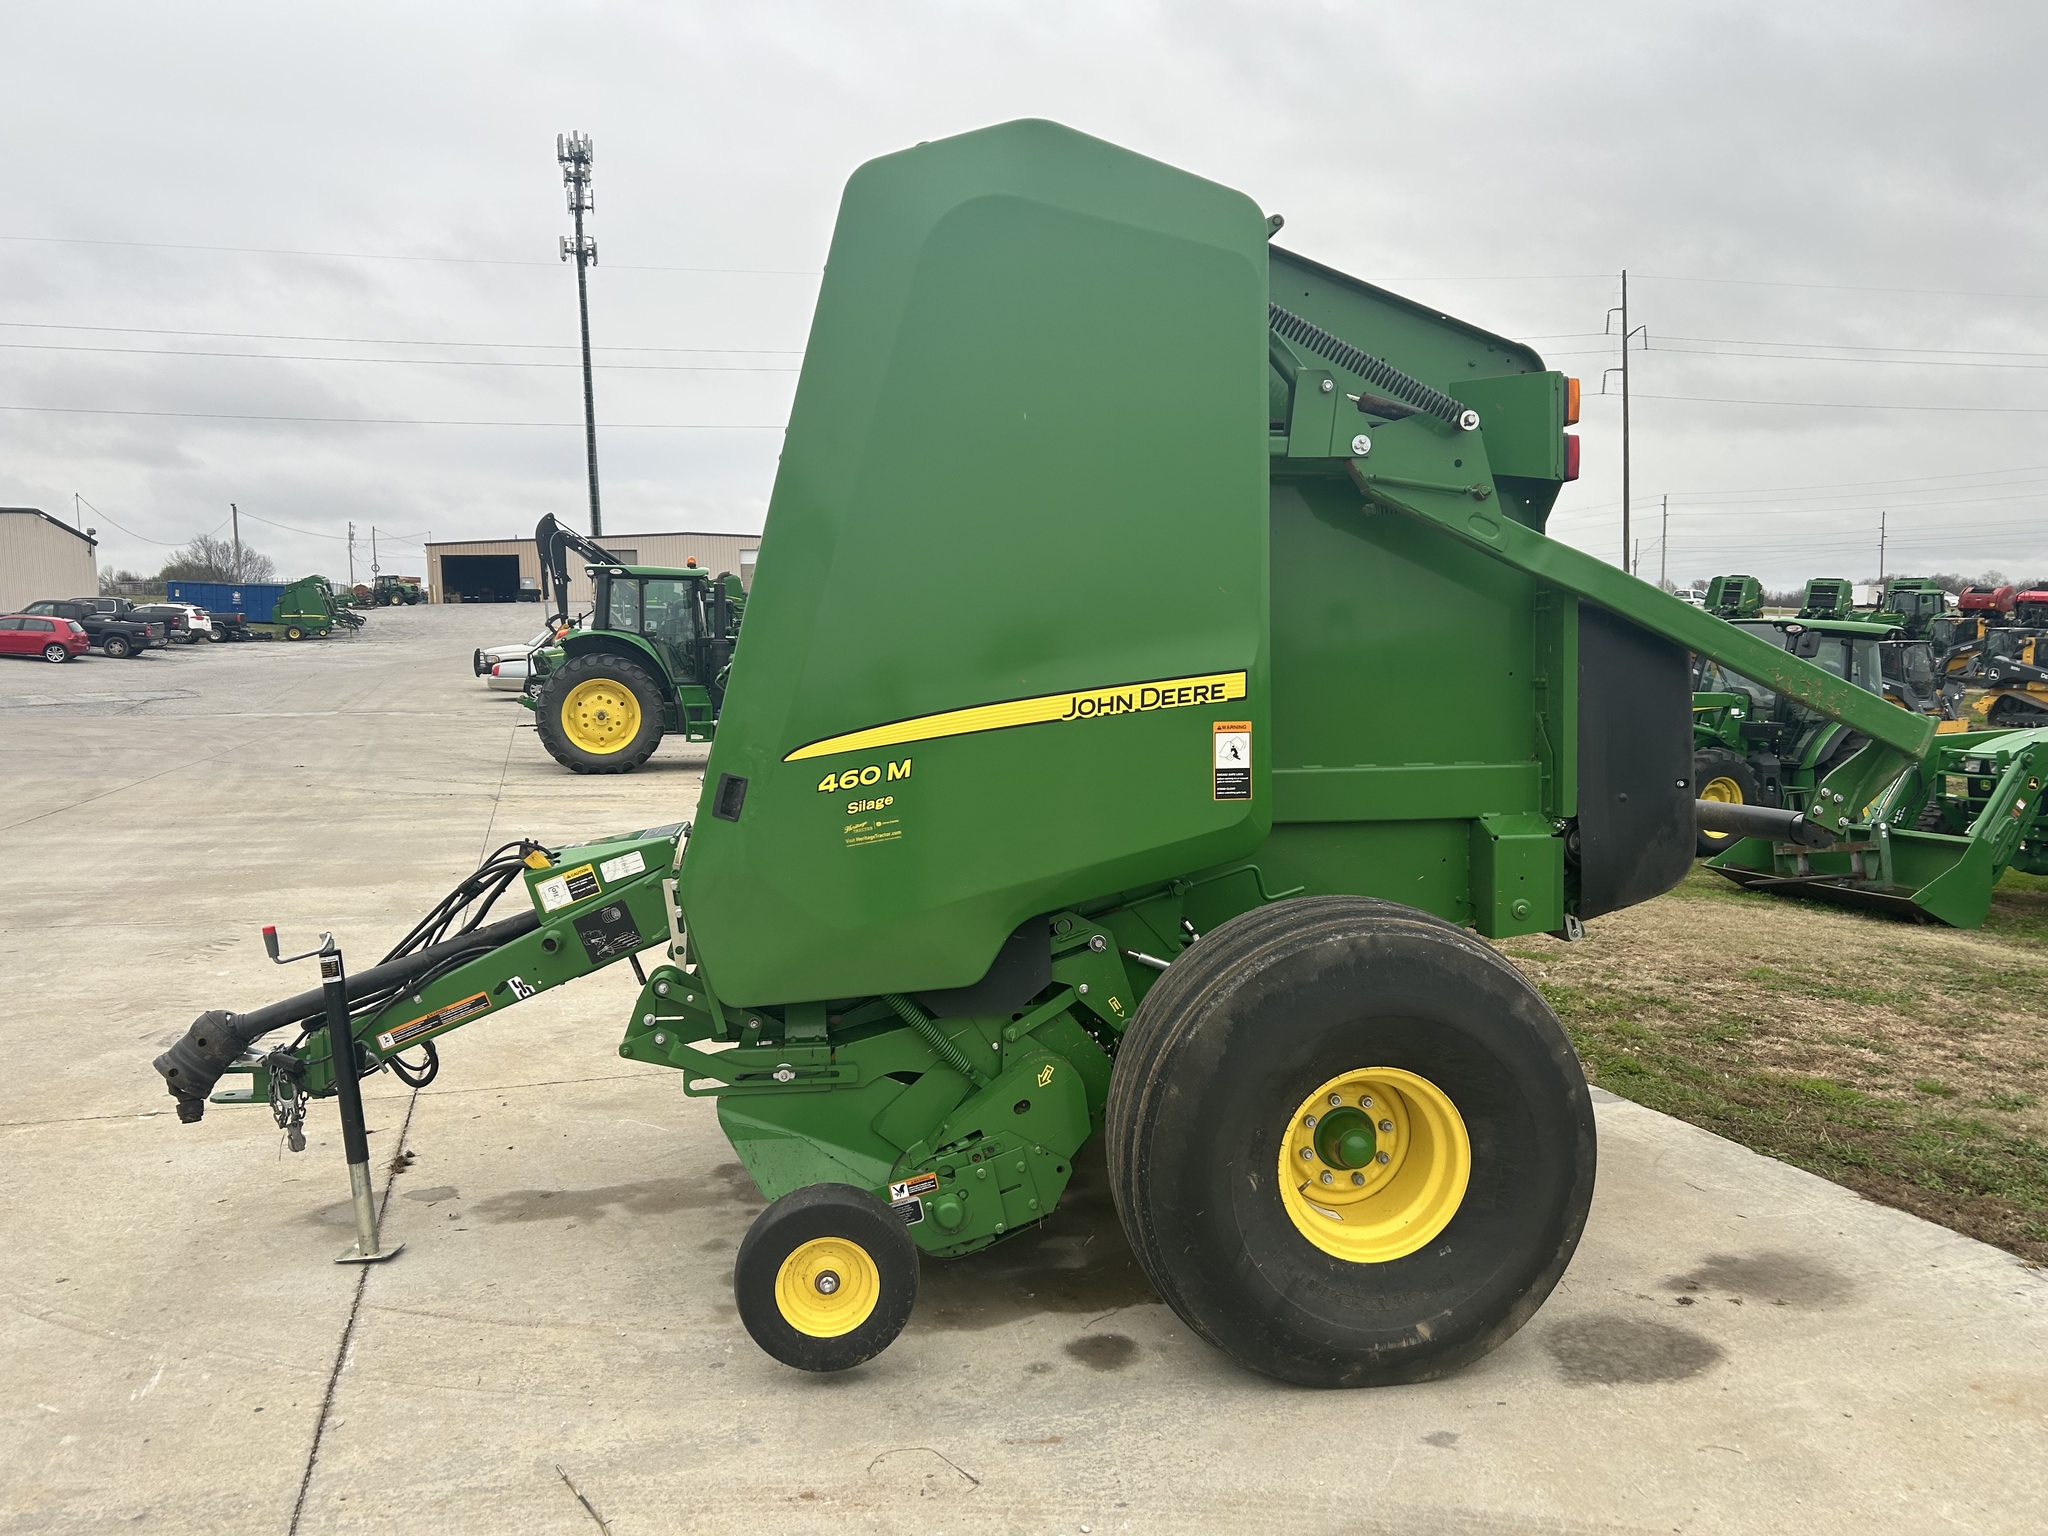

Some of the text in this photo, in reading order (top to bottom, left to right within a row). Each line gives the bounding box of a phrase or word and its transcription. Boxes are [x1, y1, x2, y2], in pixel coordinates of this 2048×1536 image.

[1063, 683, 1226, 718] JOHN DEERE
[817, 757, 913, 793] 460 M
[846, 795, 894, 815] Silage
